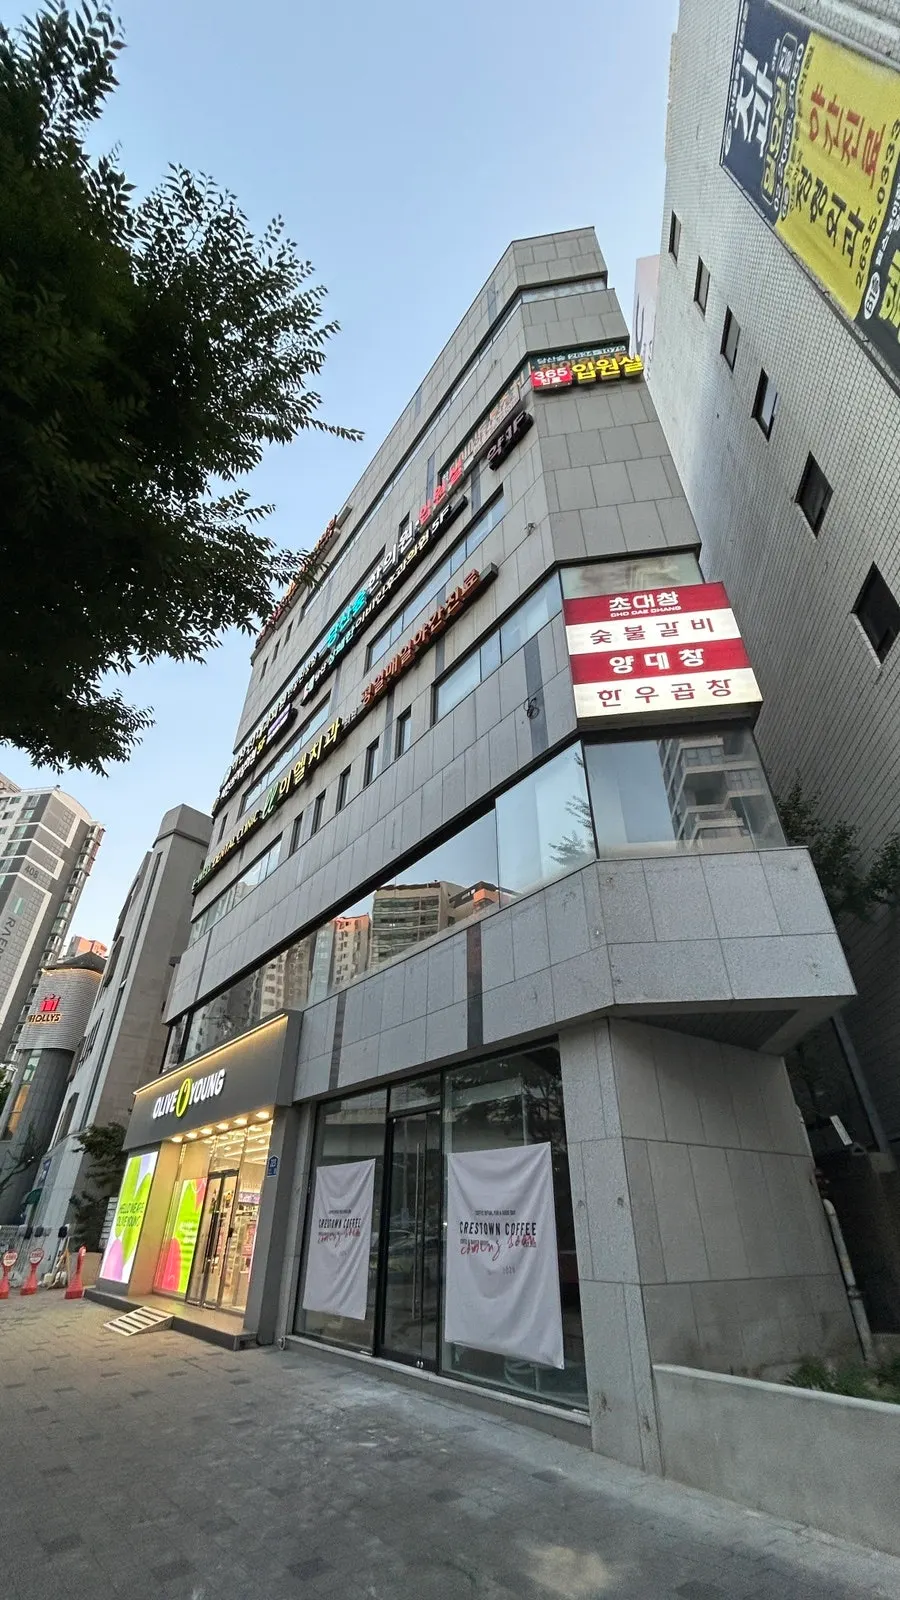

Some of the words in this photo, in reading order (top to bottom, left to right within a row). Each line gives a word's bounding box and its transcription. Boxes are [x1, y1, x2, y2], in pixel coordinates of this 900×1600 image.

[734, 49, 773, 157] 치과
[796, 165, 865, 268] 정형외과
[534, 367, 568, 380] 365
[571, 353, 644, 382] 입원실
[609, 591, 679, 612] 초대창
[590, 617, 715, 645] 숯불갈비
[609, 648, 705, 674] 양대창
[597, 678, 732, 708] 한우곱창
[28, 1013, 61, 1023] HOLLYS
[152, 1088, 179, 1120] OLIVE
[188, 1068, 226, 1106] YOUNG
[459, 1221, 501, 1235] CRESTOWN
[504, 1222, 537, 1236] COFFEE
